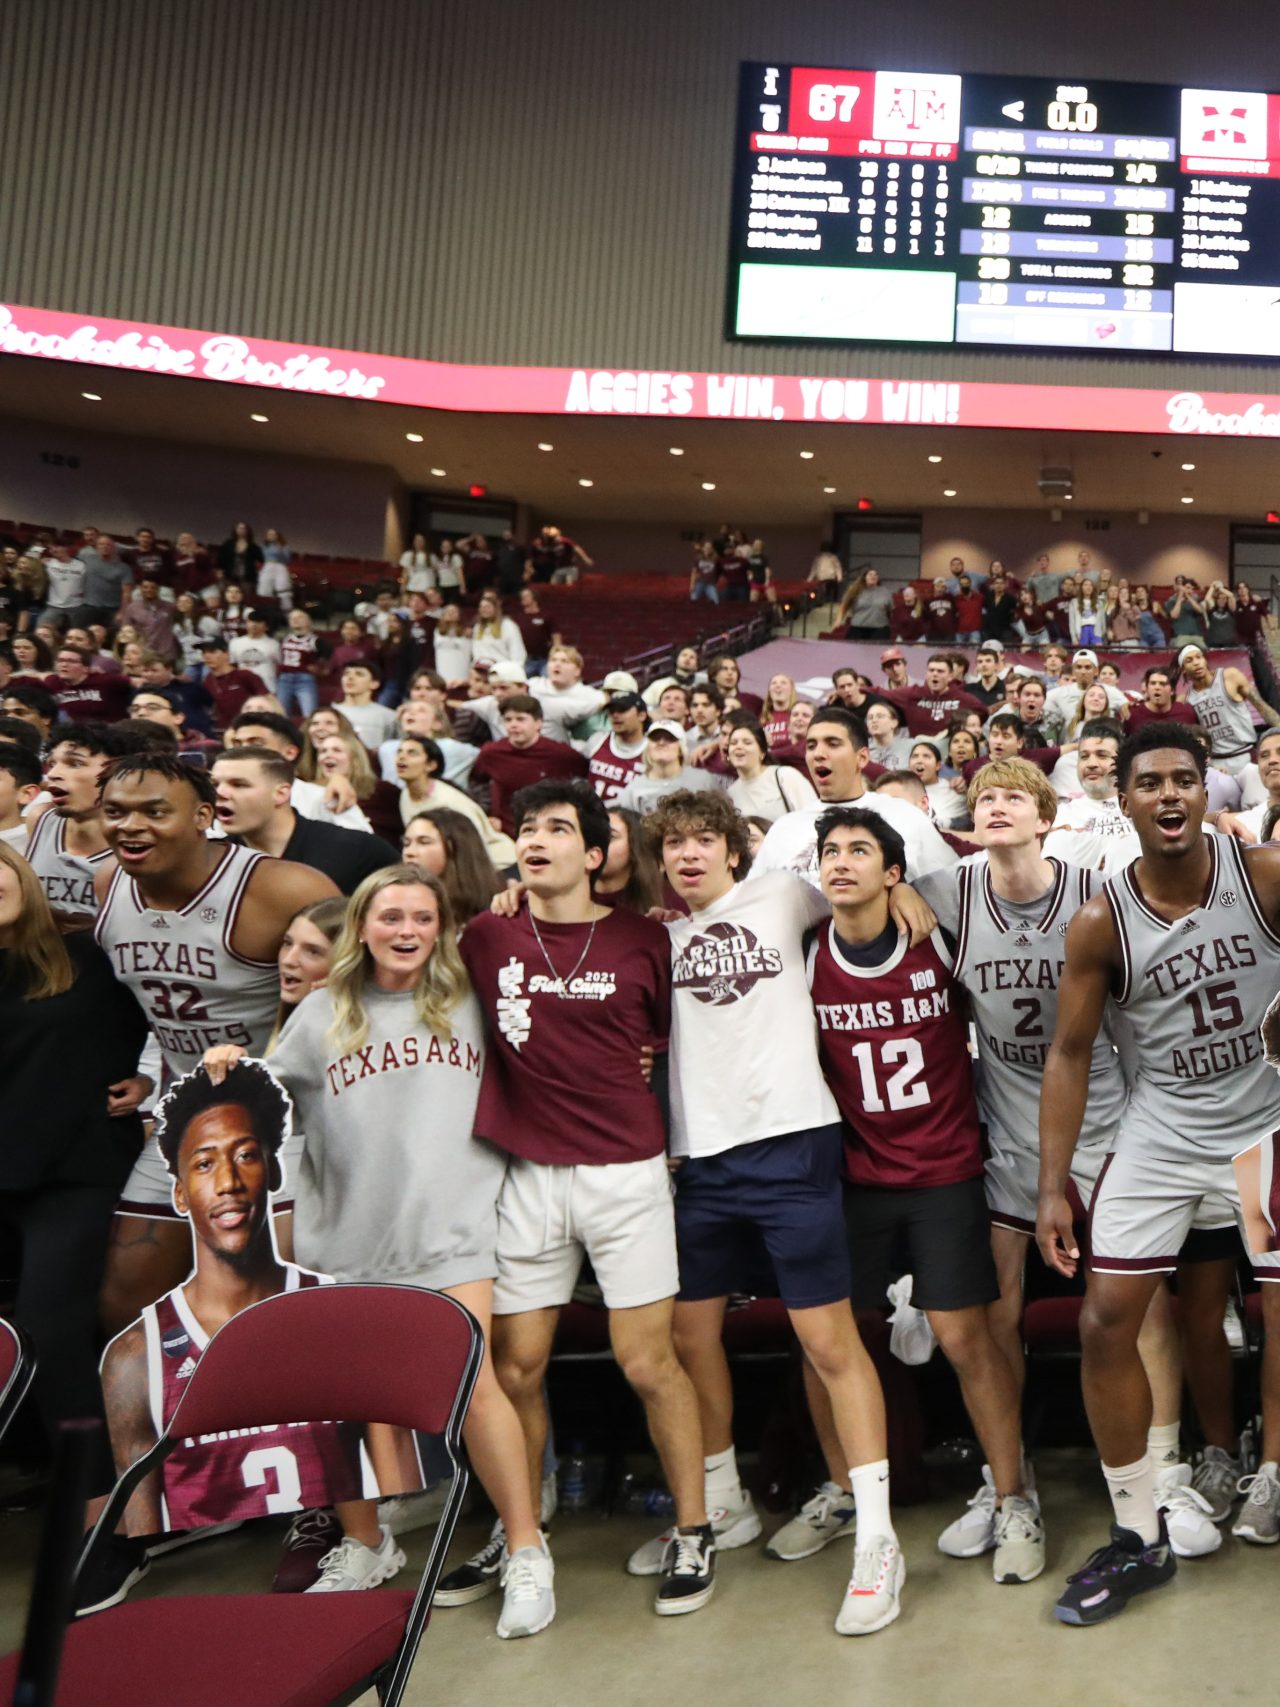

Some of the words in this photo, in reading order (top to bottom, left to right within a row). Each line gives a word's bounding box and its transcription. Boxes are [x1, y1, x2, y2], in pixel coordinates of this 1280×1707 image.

[808, 84, 860, 122] 67
[1048, 101, 1097, 132] 0.0
[201, 335, 385, 398] Brothers
[565, 371, 693, 414] AGGIES
[707, 376, 784, 420] WIN,
[800, 380, 867, 420] YOU
[882, 382, 960, 423] WIN!
[1203, 711, 1221, 729] 10
[38, 876, 98, 907] EXA
[1221, 892, 1236, 904] SEC
[114, 941, 217, 981] TEXAS
[690, 934, 748, 963] REED
[1145, 934, 1257, 998] TEXAS
[528, 975, 566, 993] Fish
[569, 978, 617, 1001] Camp
[585, 971, 616, 983] 2021
[909, 969, 936, 992] 100
[141, 979, 209, 1021] 32
[816, 999, 894, 1031] TEXAS
[903, 989, 950, 1025] A&M
[1013, 998, 1043, 1037] 2
[1185, 980, 1243, 1037] 15
[326, 1038, 419, 1096] TEXAS
[425, 1035, 481, 1078] A&M
[852, 1037, 931, 1113] 12
